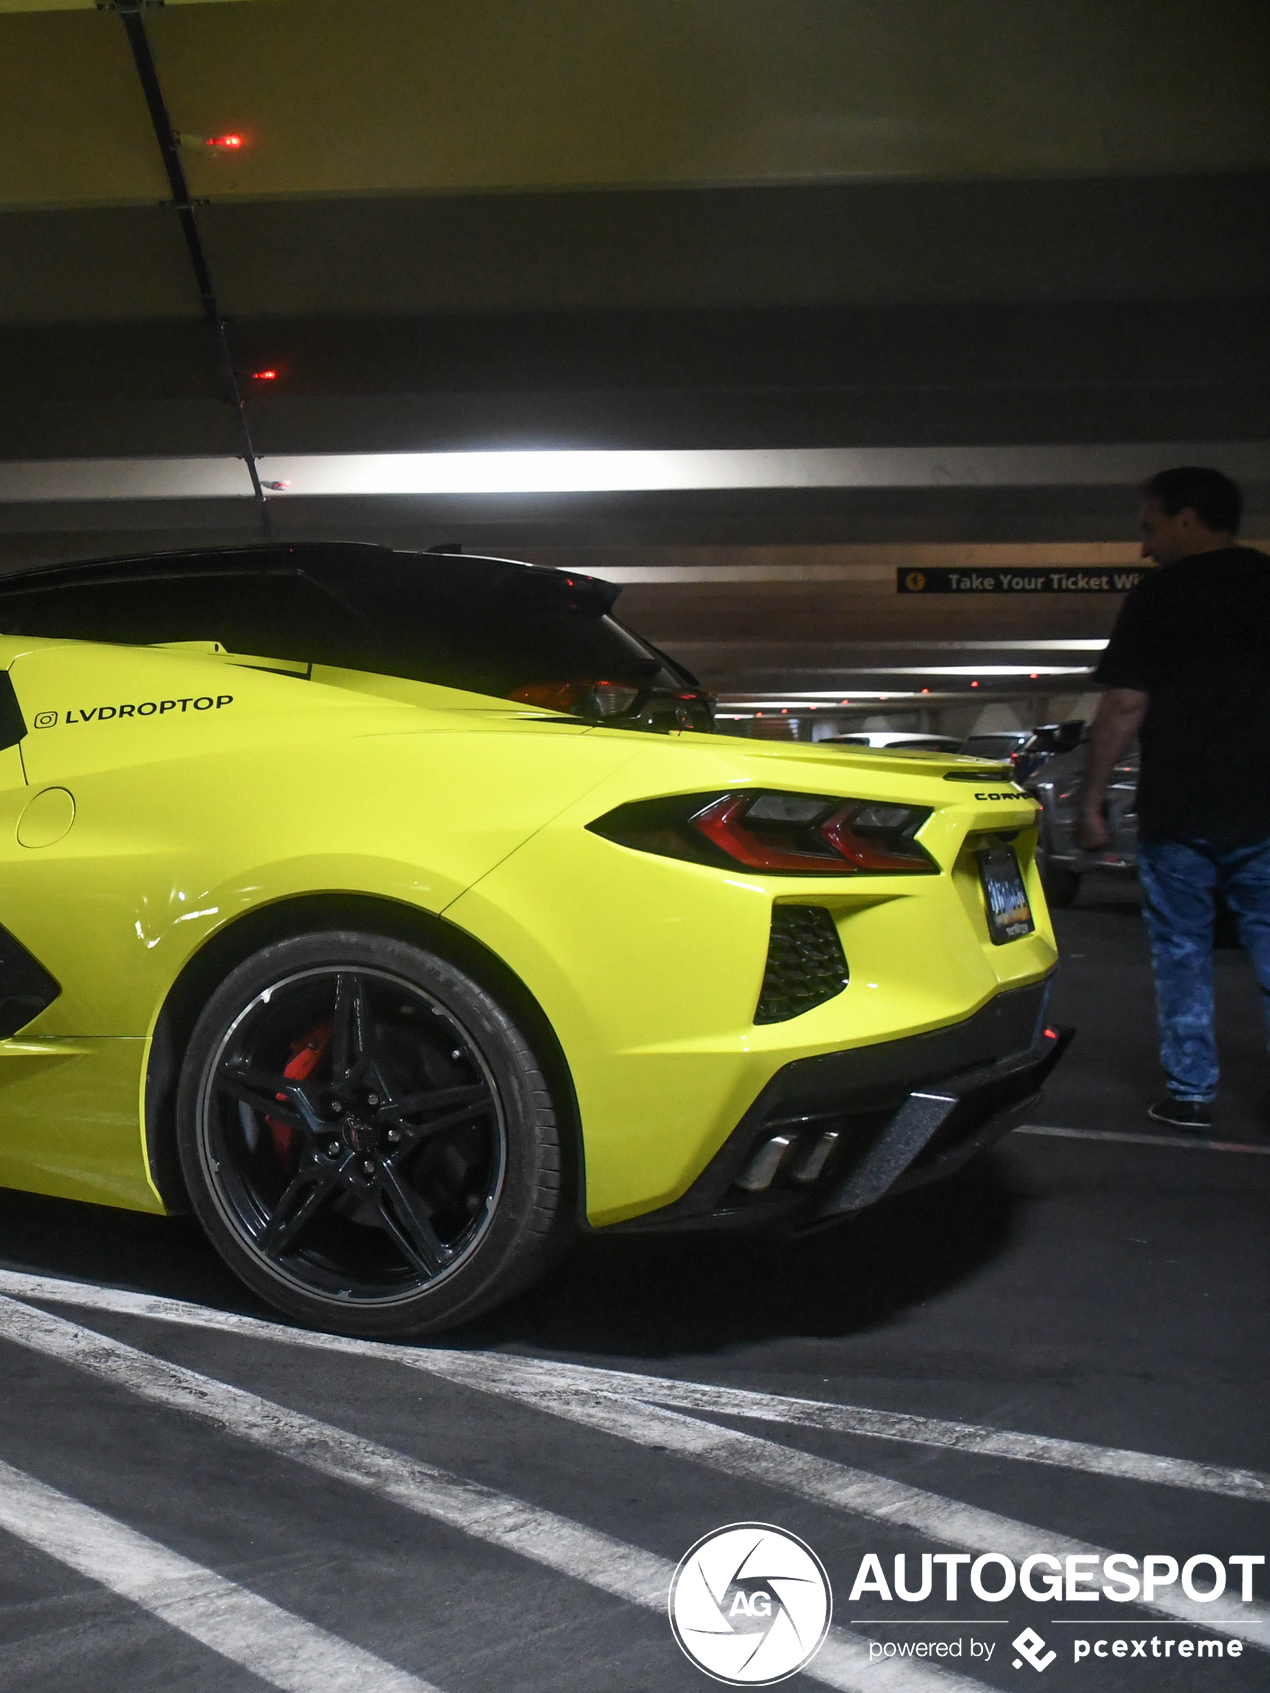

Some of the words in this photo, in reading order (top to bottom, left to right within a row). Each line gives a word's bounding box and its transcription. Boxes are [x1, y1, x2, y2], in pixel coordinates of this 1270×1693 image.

[948, 573, 995, 590] Take
[999, 573, 1046, 590] Your
[1049, 573, 1110, 590] Ticket
[1113, 573, 1144, 590] Wi
[65, 695, 234, 724] LVDROPTOP
